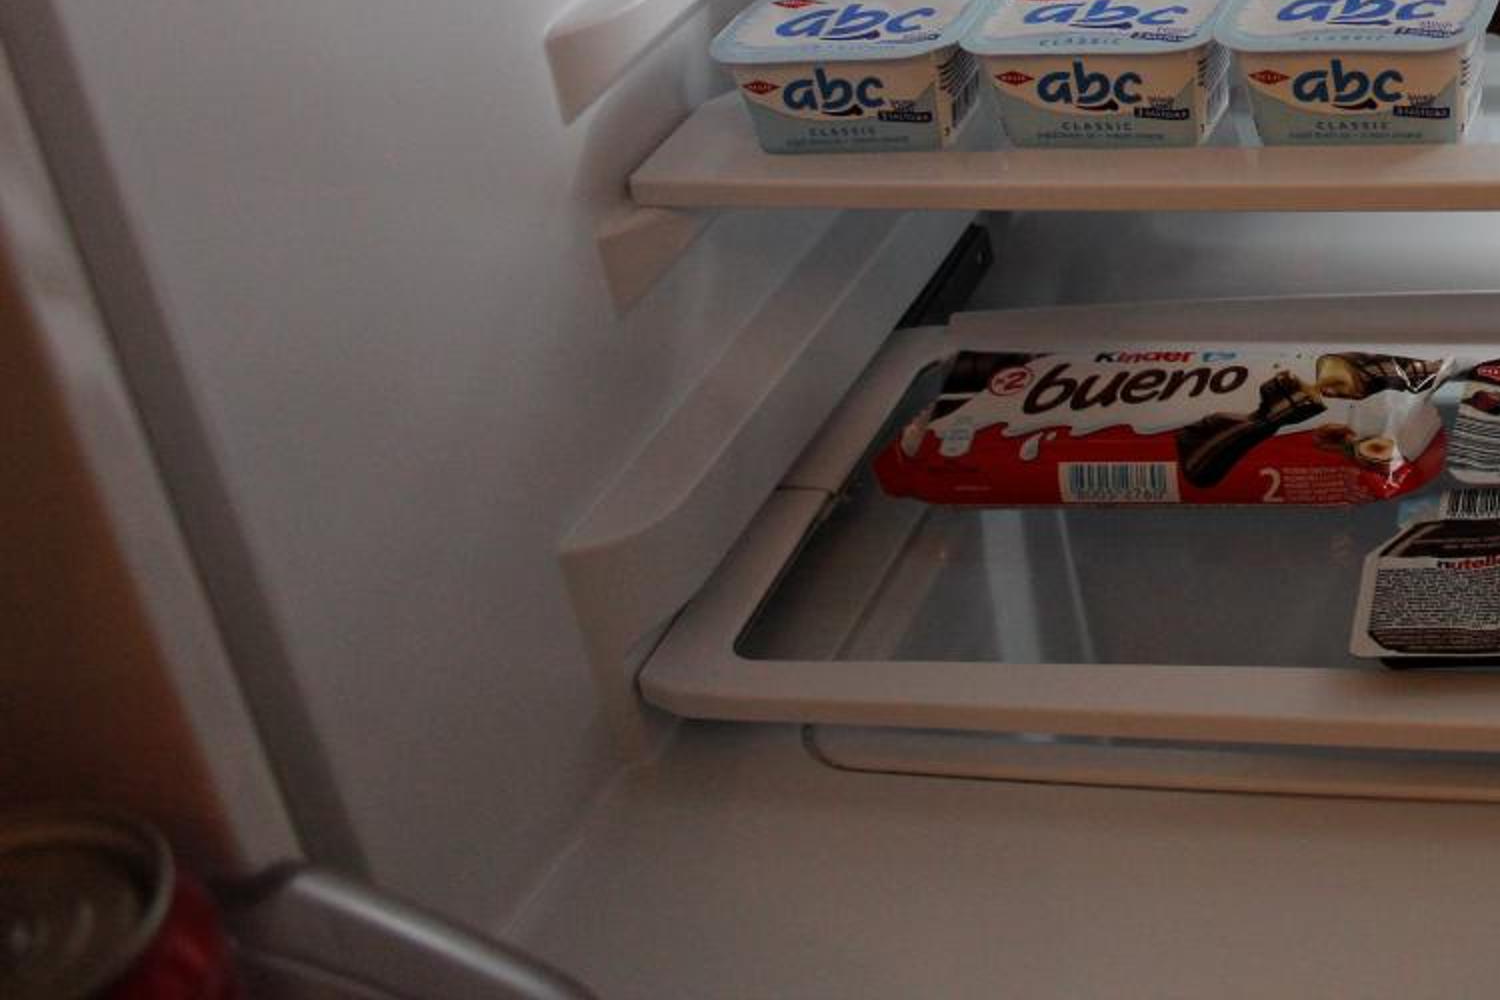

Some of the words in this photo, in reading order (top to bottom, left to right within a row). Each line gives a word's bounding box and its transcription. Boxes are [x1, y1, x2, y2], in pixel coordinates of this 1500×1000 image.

[776, 3, 937, 38] abc
[782, 64, 885, 111] abc
[1036, 57, 1144, 104] abc
[1292, 57, 1405, 103] abc
[1061, 121, 1133, 131] CLASSIC
[1315, 120, 1392, 130] CLASSIC
[1024, 363, 1249, 414] bueno
[1258, 466, 1284, 503] 2
